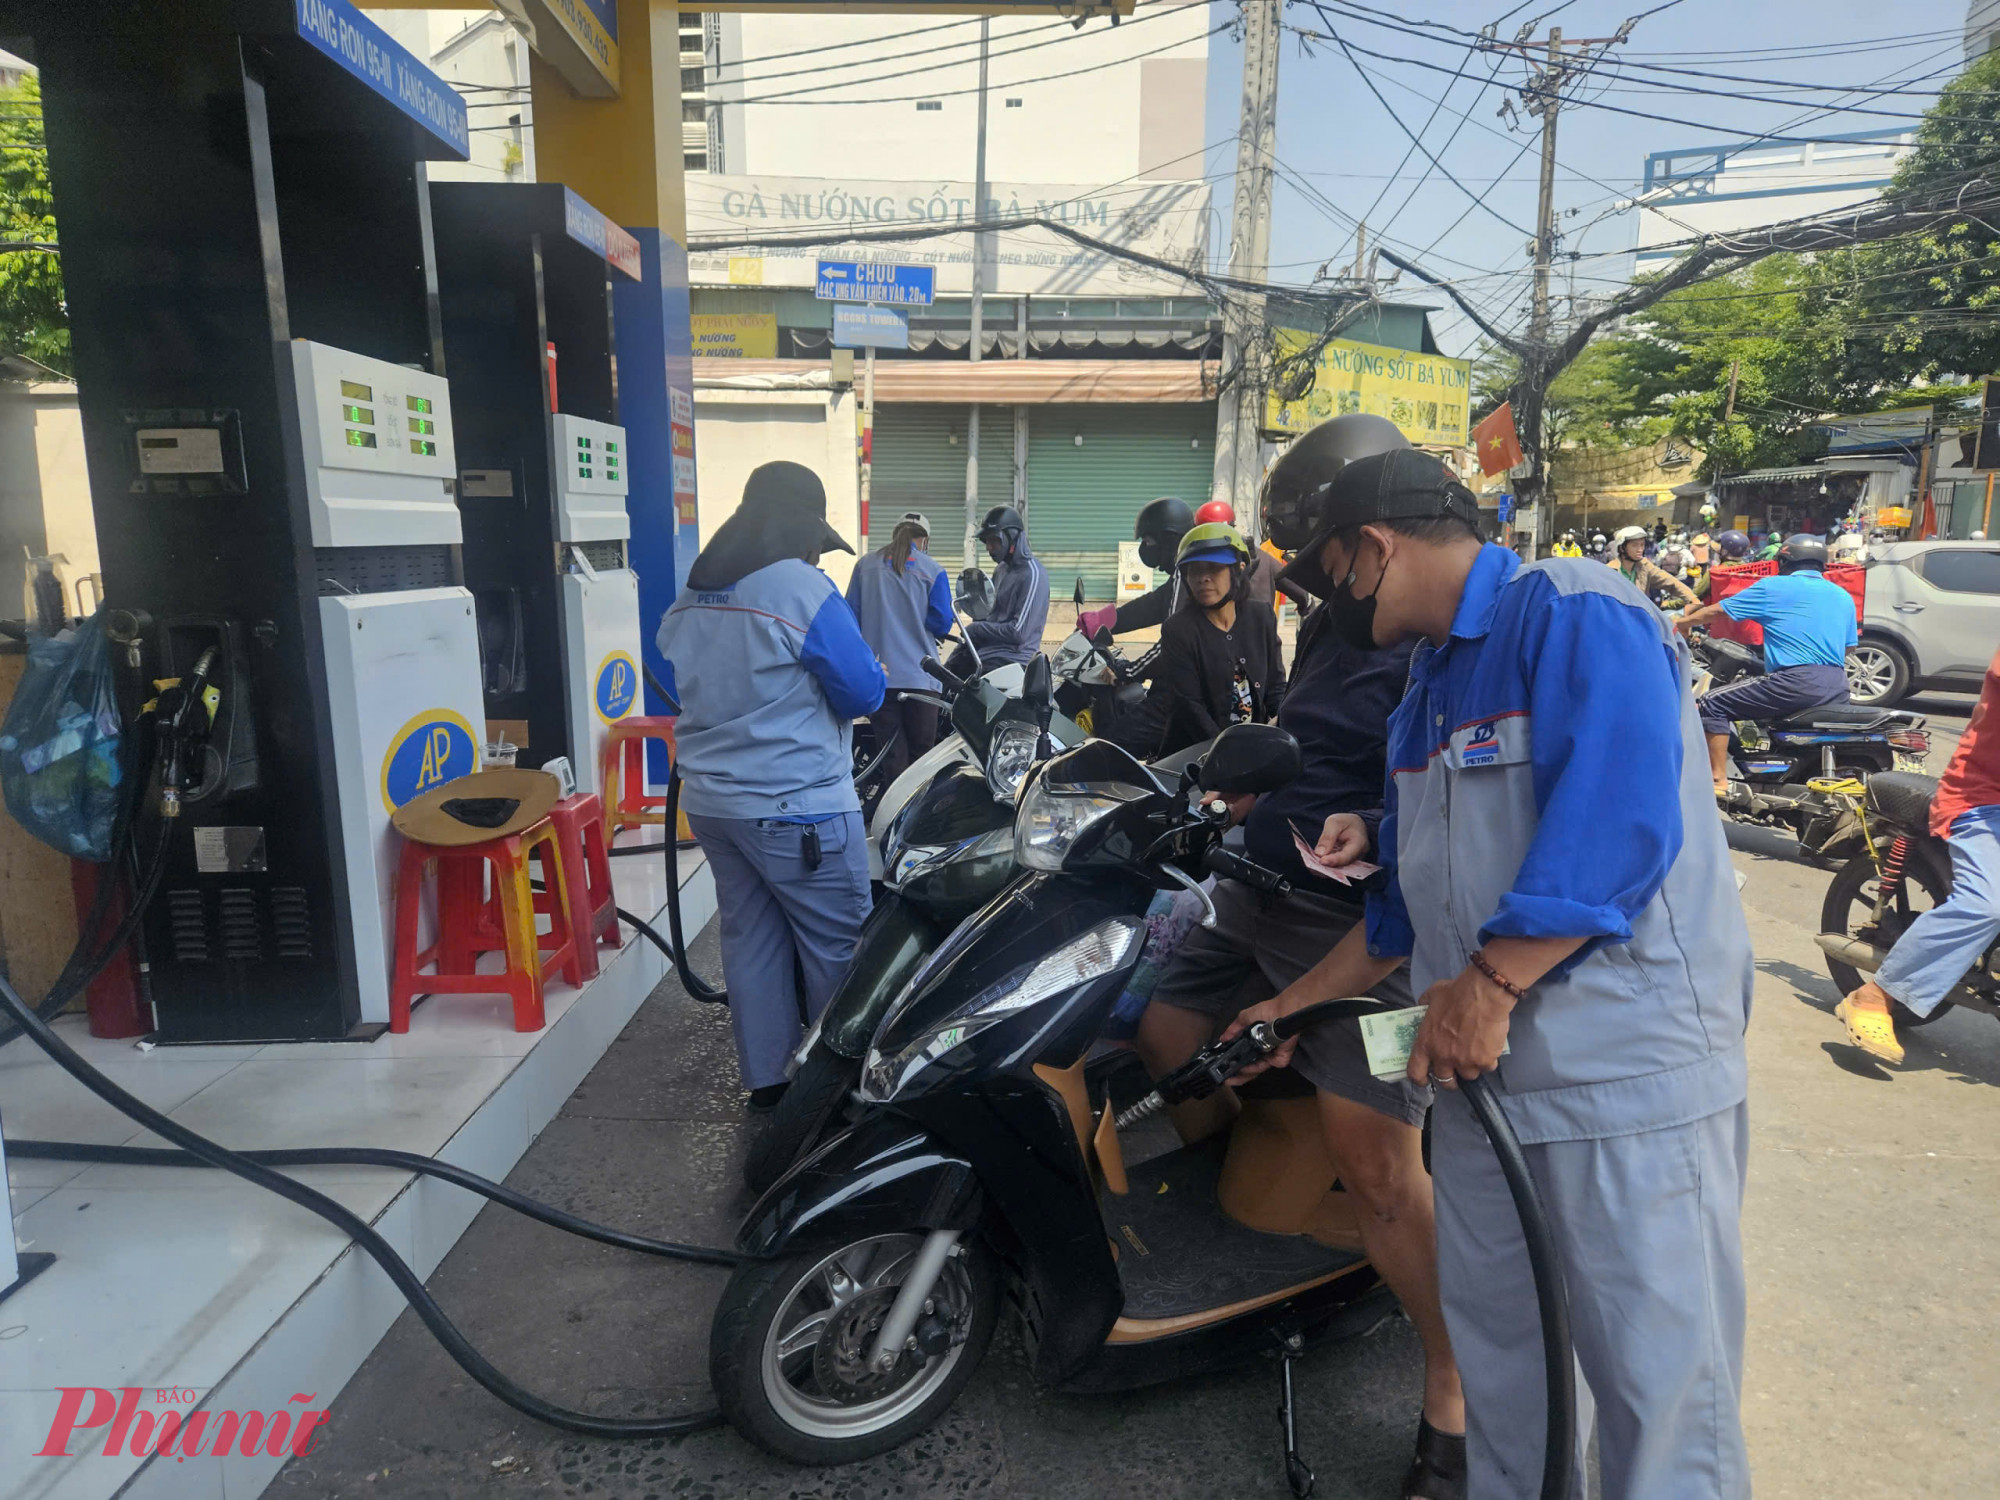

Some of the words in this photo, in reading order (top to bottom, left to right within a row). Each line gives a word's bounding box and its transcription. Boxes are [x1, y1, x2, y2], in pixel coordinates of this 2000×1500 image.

[339, 17, 366, 71] RON
[426, 86, 447, 131] RON
[722, 184, 768, 219] GÀ
[780, 187, 896, 222] NƯỚNG
[907, 185, 970, 223] SỐT
[984, 191, 1024, 224] BÀ
[1037, 198, 1110, 227] YUM
[818, 281, 834, 298] 44C
[698, 332, 736, 343] NƯỚNG
[706, 346, 744, 358] NƯỚNG
[1332, 347, 1384, 377] NƯỚNG
[1387, 351, 1414, 381] SỐT
[1417, 359, 1436, 385] BÀ
[1439, 367, 1466, 389] YUM
[697, 594, 730, 604] PETRO
[609, 662, 626, 701] AP
[415, 727, 451, 790] AP
[1465, 755, 1494, 766] PETRO
